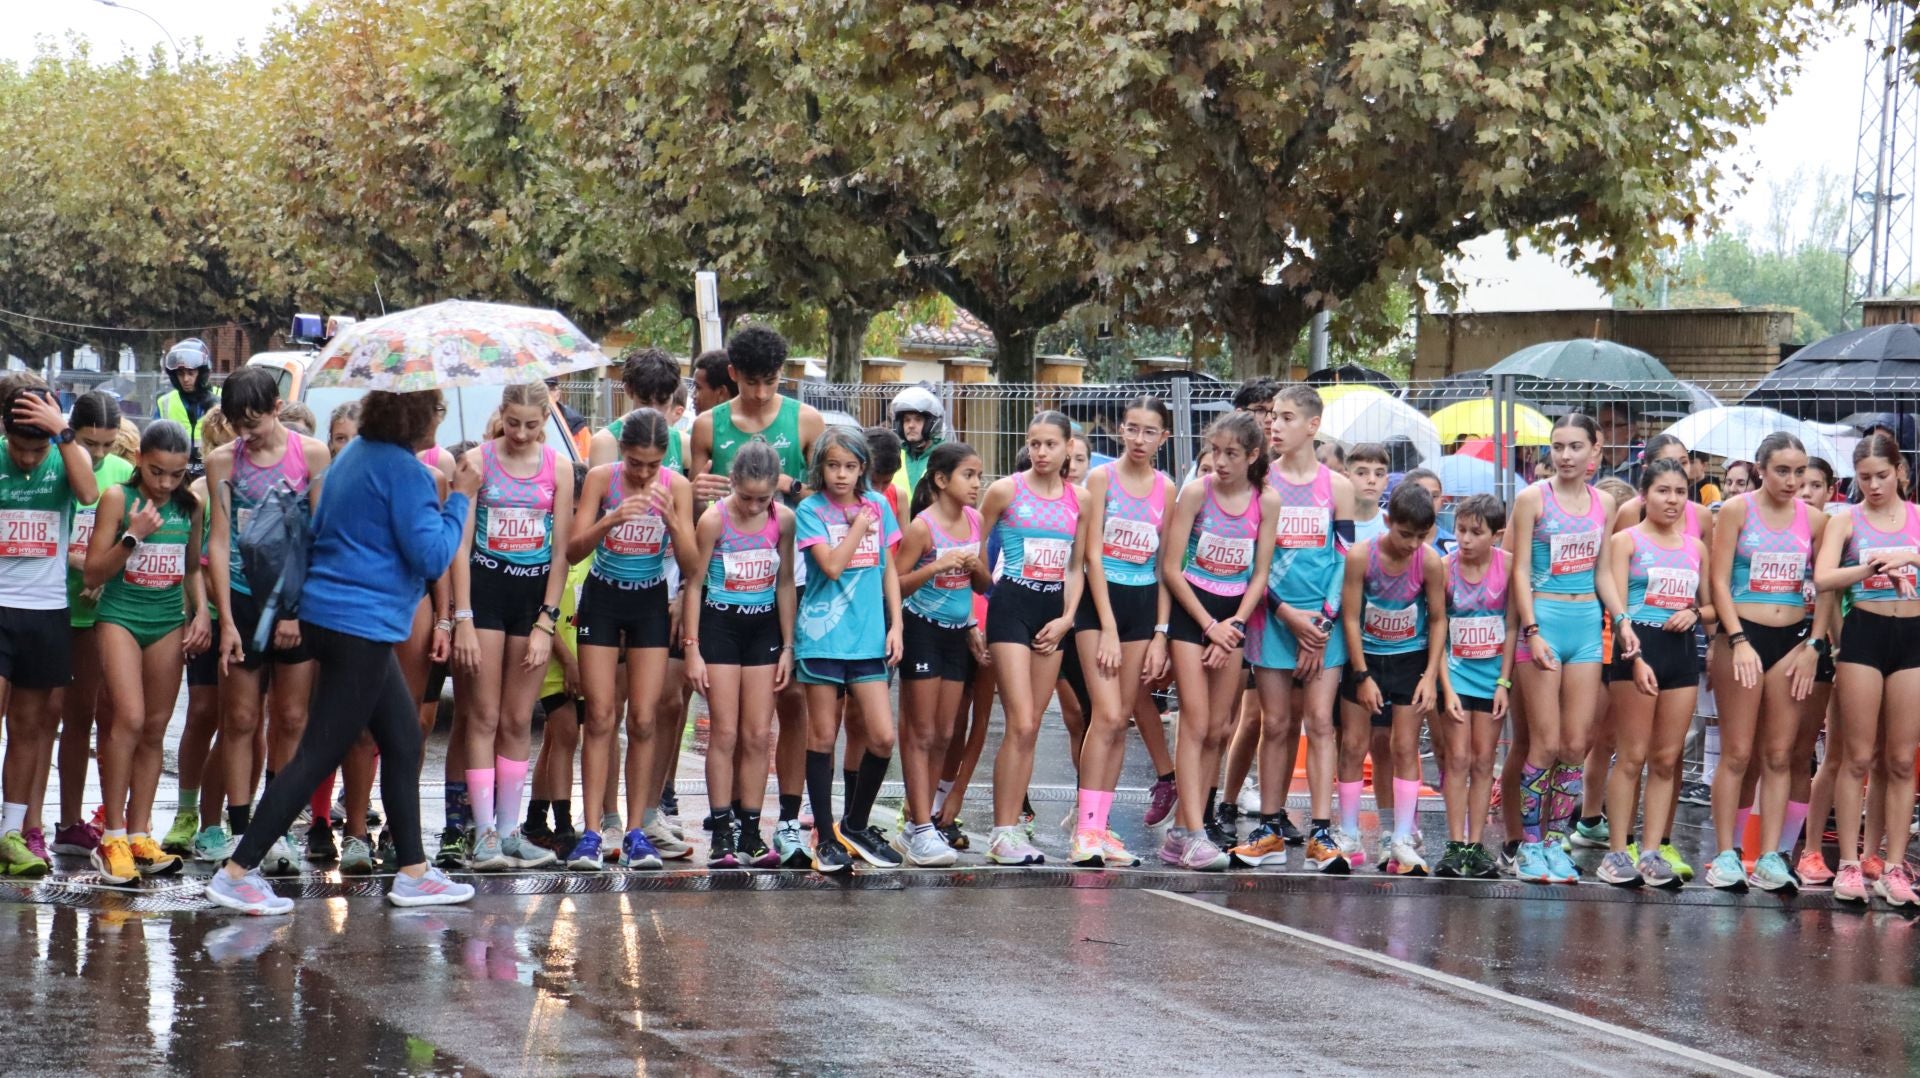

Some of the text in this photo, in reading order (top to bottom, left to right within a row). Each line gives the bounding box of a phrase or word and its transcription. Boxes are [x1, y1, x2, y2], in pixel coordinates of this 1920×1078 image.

[9, 521, 47, 541] 2018
[615, 524, 655, 542] 2037
[1282, 517, 1319, 534] 2006
[1113, 528, 1150, 550] 2044
[1034, 548, 1066, 567] 2049
[1205, 544, 1244, 564] 2053
[1560, 541, 1595, 561] 2046
[137, 554, 176, 573] 2063
[474, 551, 550, 577] PRO NIKE P
[735, 560, 772, 579] 2079
[1760, 562, 1797, 579] 2048
[1210, 581, 1241, 593] NIKE
[1659, 577, 1689, 596] 2041
[737, 604, 772, 615] NIKE
[1373, 614, 1409, 631] 2003
[1459, 626, 1496, 645] 2004
